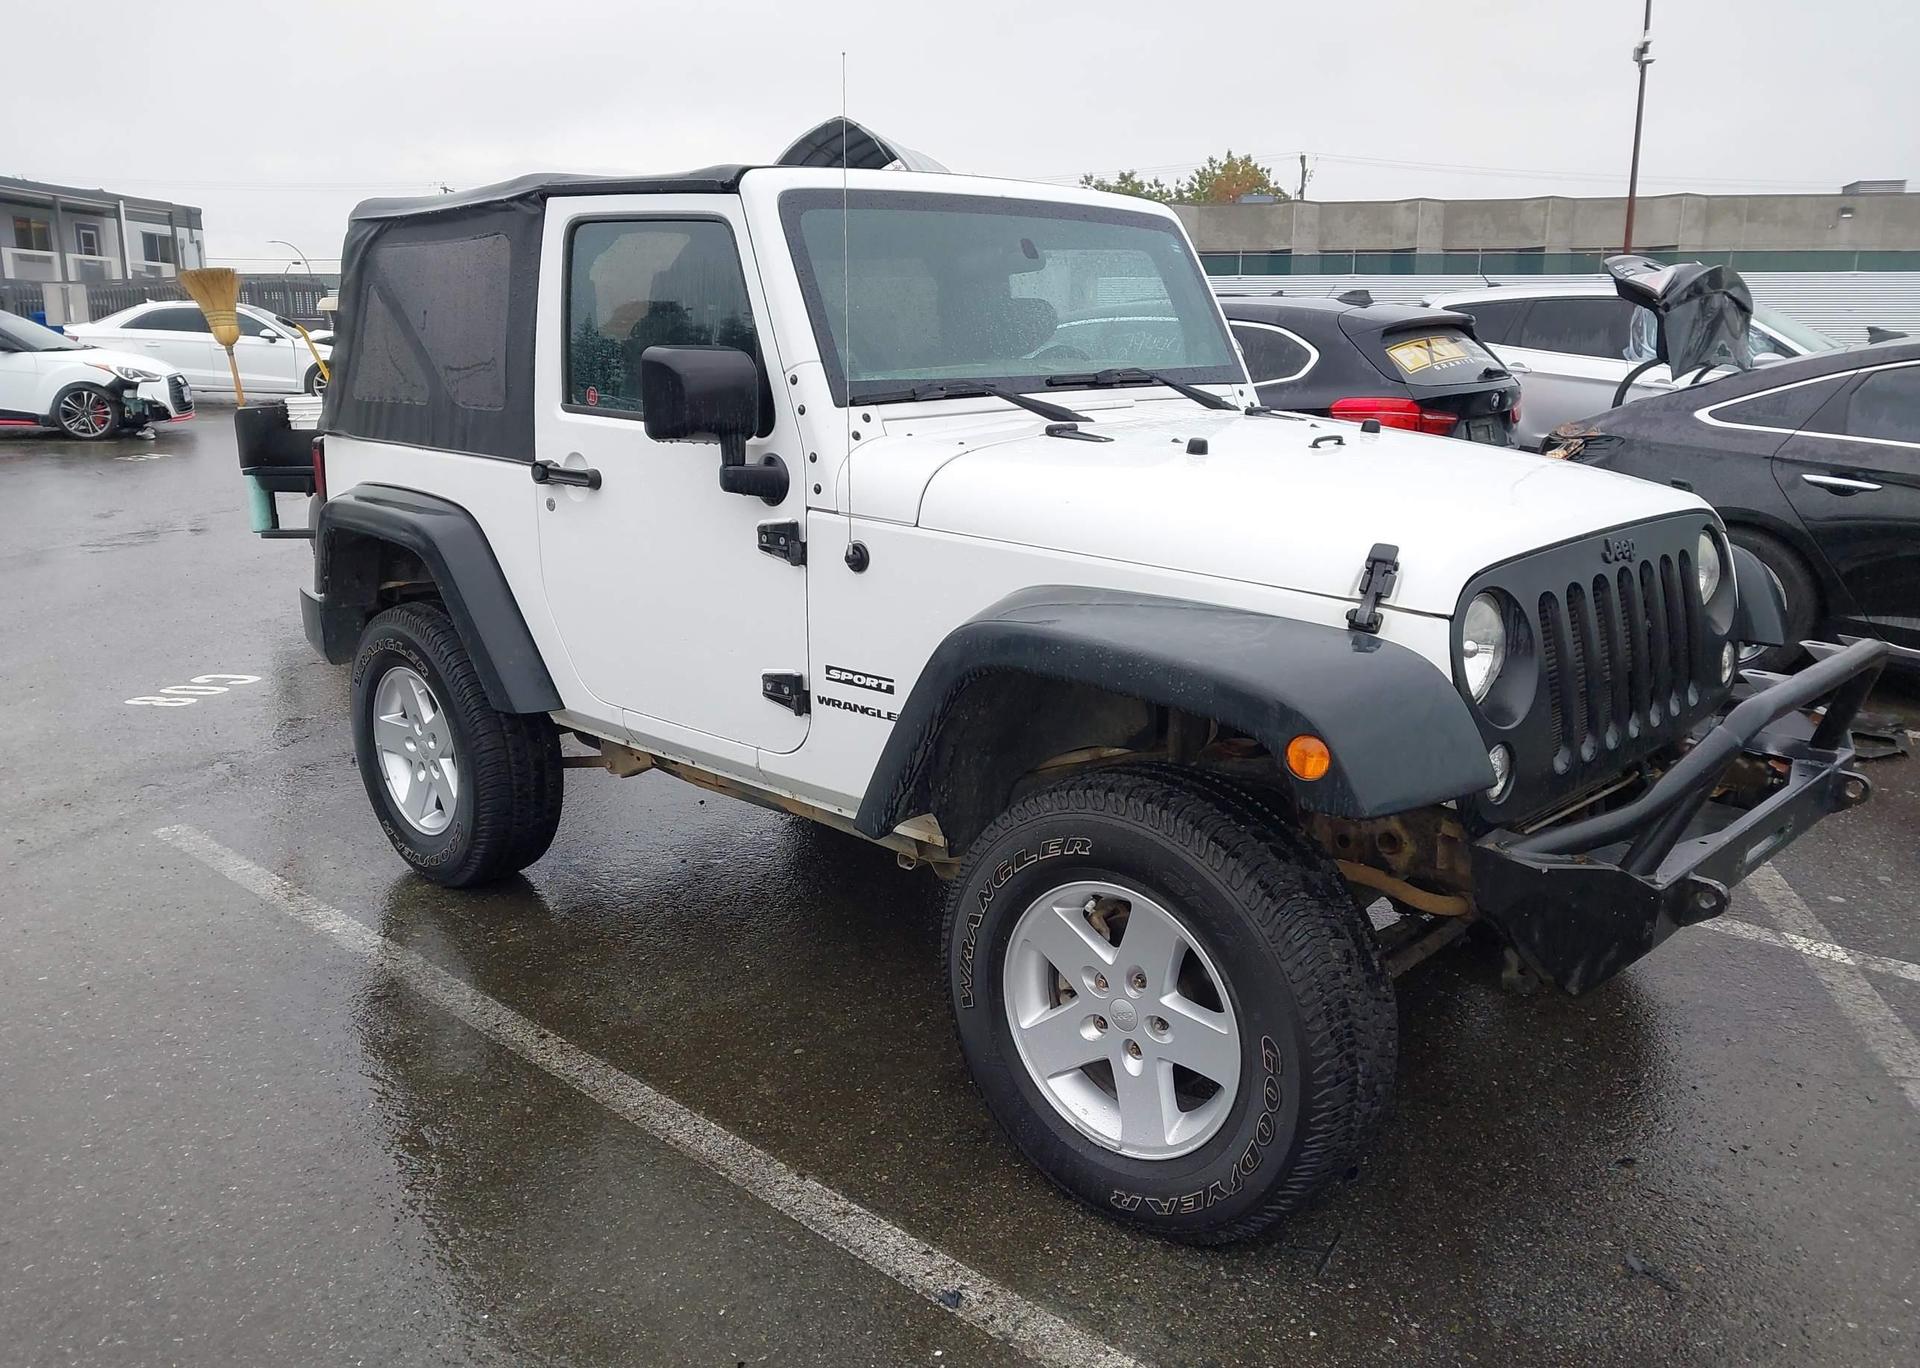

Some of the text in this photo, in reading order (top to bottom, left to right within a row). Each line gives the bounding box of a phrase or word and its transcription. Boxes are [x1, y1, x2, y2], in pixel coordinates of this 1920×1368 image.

[1601, 537, 1636, 564] Jeep
[354, 638, 429, 687] WRANGLER
[825, 667, 895, 691] SPORT
[817, 695, 899, 722] WRANGLE
[383, 820, 464, 867] GOODYEAR
[958, 836, 1094, 1009] WRANGLER
[1110, 1034, 1283, 1216] GOODYEAR
